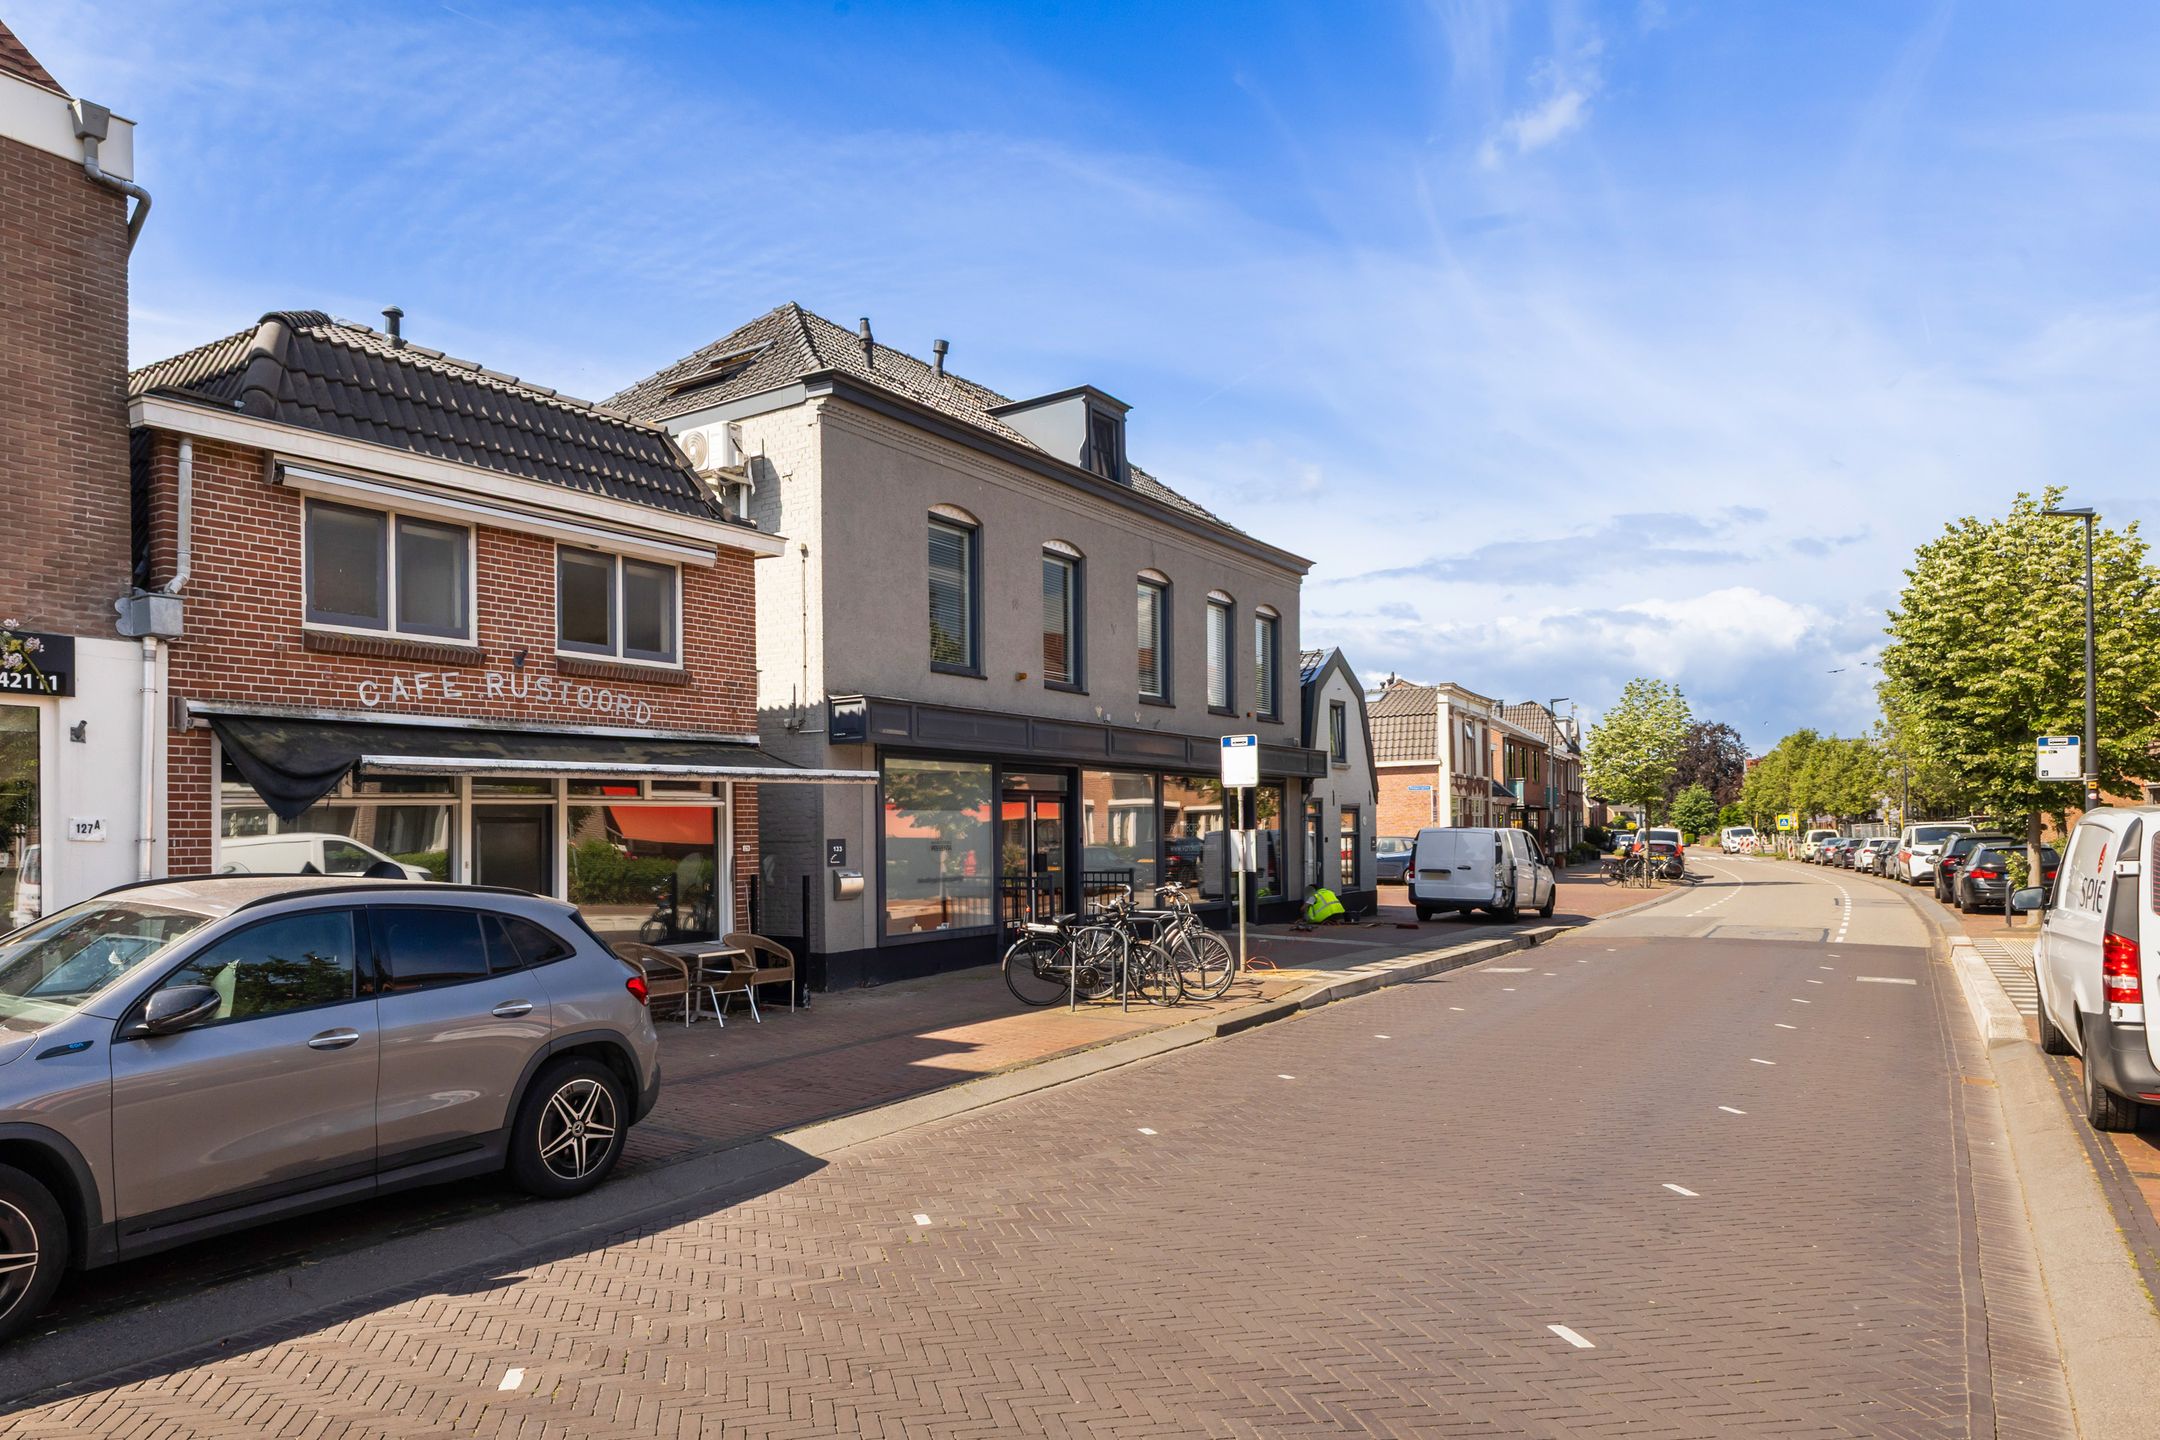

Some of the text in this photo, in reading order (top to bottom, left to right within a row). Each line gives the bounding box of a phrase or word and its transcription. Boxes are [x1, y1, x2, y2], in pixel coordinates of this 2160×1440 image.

[359, 672, 651, 724] CAFE RUSTOORD
[2080, 877, 2106, 913] SPIE
